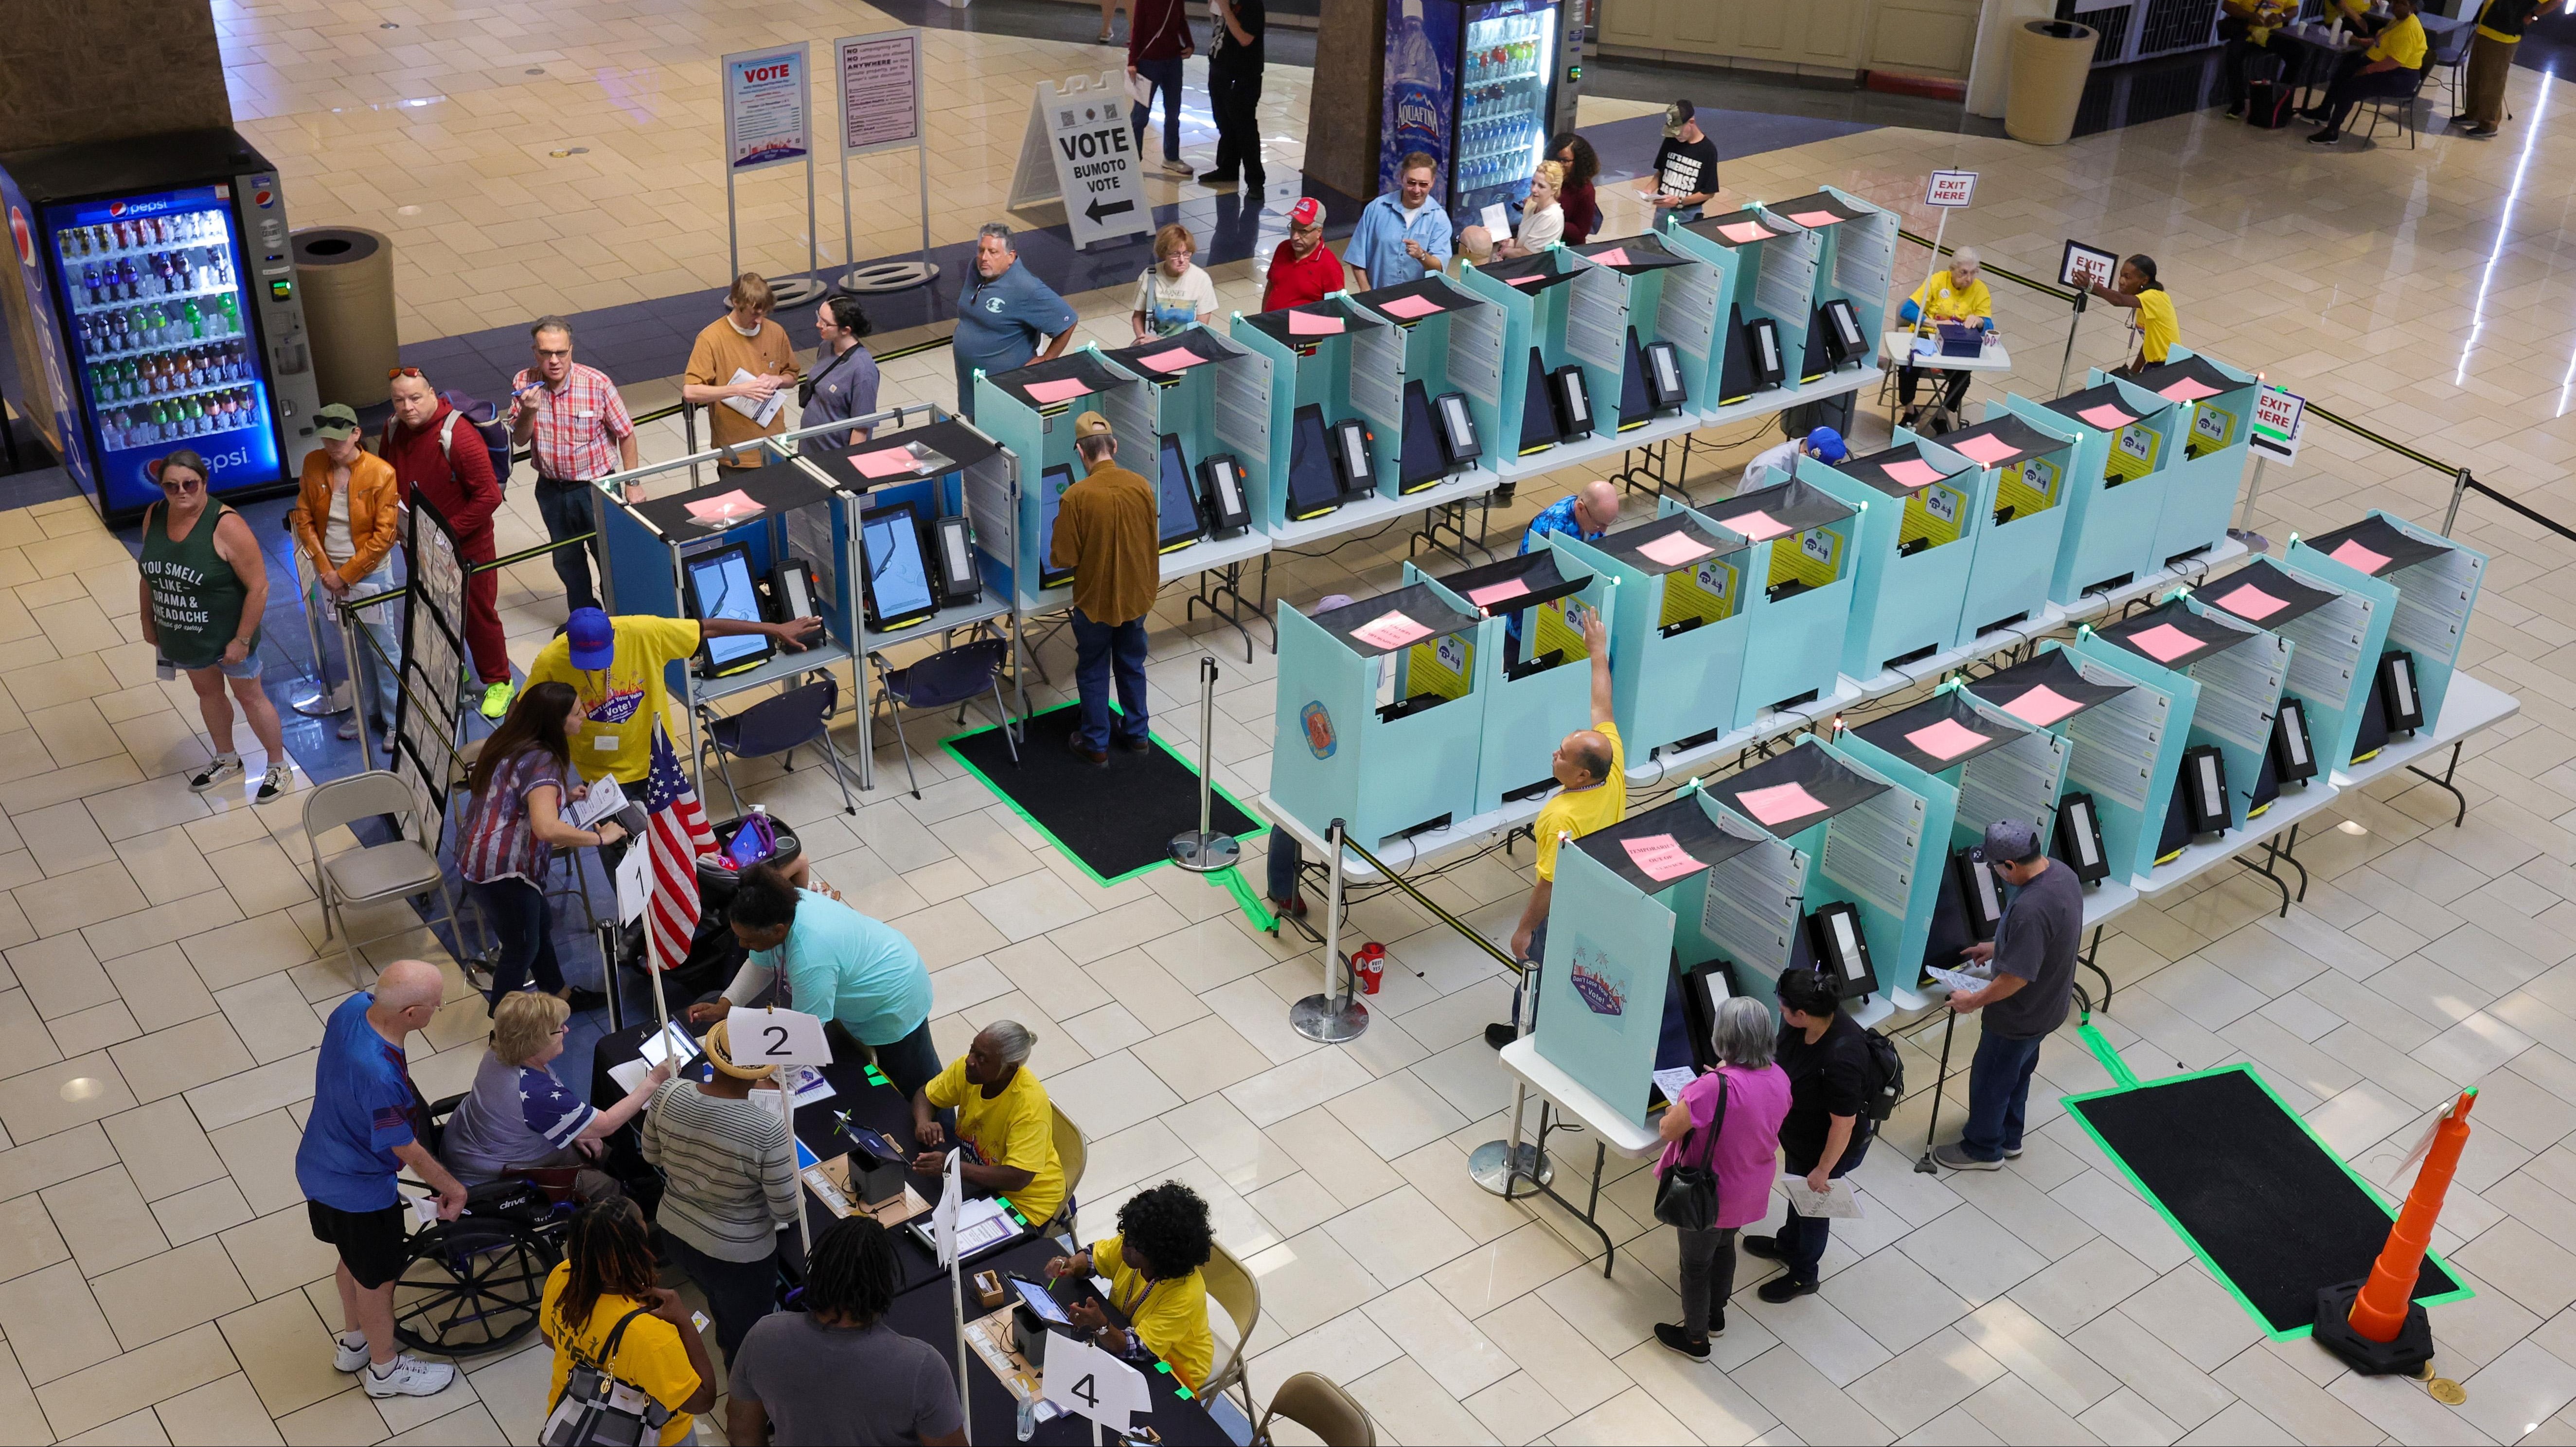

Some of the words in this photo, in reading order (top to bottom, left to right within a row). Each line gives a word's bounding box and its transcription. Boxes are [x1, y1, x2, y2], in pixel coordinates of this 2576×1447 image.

[848, 59, 891, 70] ANYWHERE
[744, 64, 789, 83] VOTE
[1397, 103, 1439, 137] AQUAFINA
[1059, 127, 1129, 161] VOTE
[1073, 159, 1126, 179] BUMOTO
[1666, 159, 1699, 178] AMERICA
[1681, 156, 1703, 169] MAKE
[1087, 176, 1120, 193] VOTE
[1938, 180, 1967, 189] EXIT
[1934, 191, 1966, 199] HERE
[130, 199, 167, 214] pepsi
[2076, 256, 2106, 272] EXIT
[2260, 395, 2292, 413] EXIT
[200, 446, 247, 473] epsi
[142, 561, 161, 574] YOU
[164, 562, 203, 586] SMELL
[153, 589, 187, 607] DRAMA
[189, 596, 198, 608] &
[183, 625, 203, 633] away
[589, 705, 603, 718] Don't
[605, 700, 632, 716] Vote!
[1629, 843, 1675, 855] TEMPORARILY
[636, 865, 645, 898] 1
[1586, 978, 1598, 988] Lose
[1599, 984, 1608, 998] Your
[1609, 996, 1619, 1013] Voice
[1588, 987, 1604, 1004] Vote!
[763, 1026, 793, 1056] 2
[499, 1197, 525, 1210] drive
[534, 1208, 554, 1222] driv
[1071, 1374, 1099, 1409] 4
